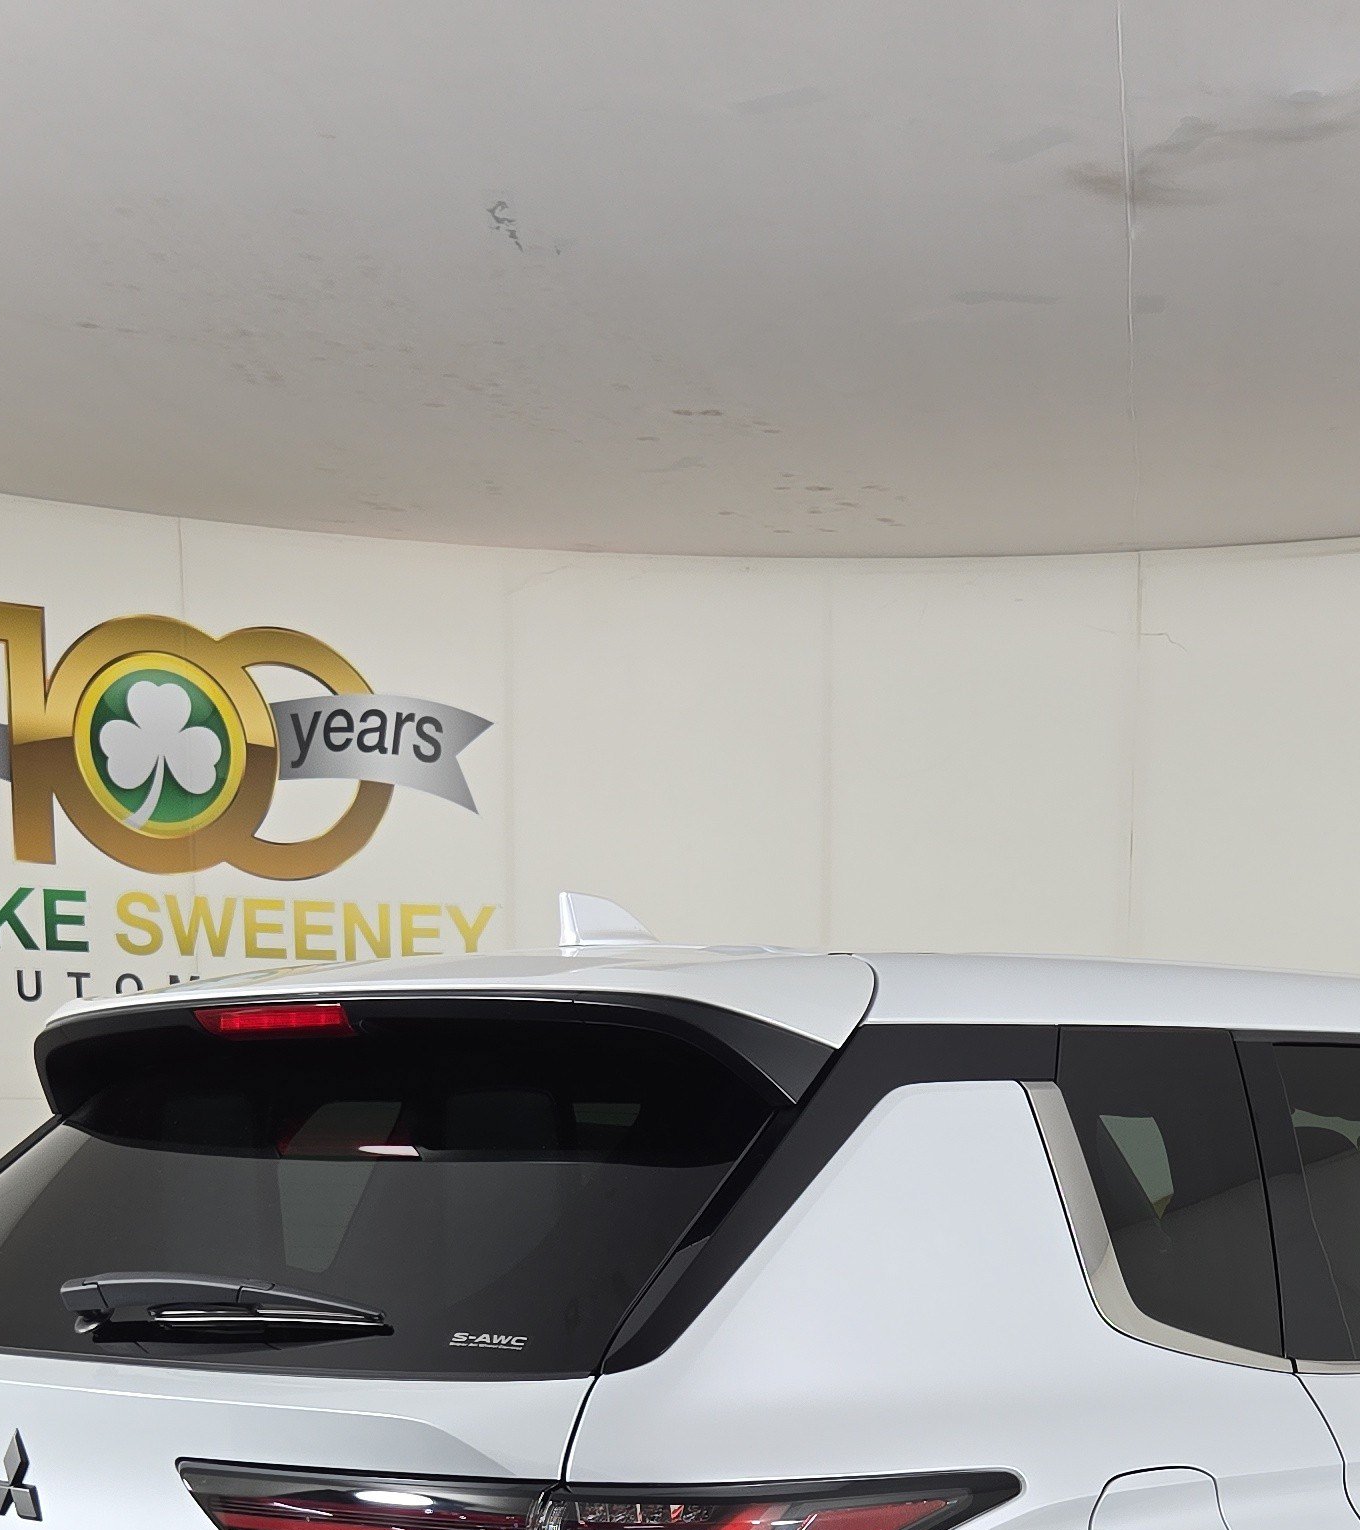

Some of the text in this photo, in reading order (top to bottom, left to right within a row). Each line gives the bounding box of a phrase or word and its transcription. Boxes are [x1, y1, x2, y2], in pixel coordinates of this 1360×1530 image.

[289, 708, 444, 768] years
[115, 891, 496, 961] SWEENEY
[451, 1332, 528, 1346] S-AWC
